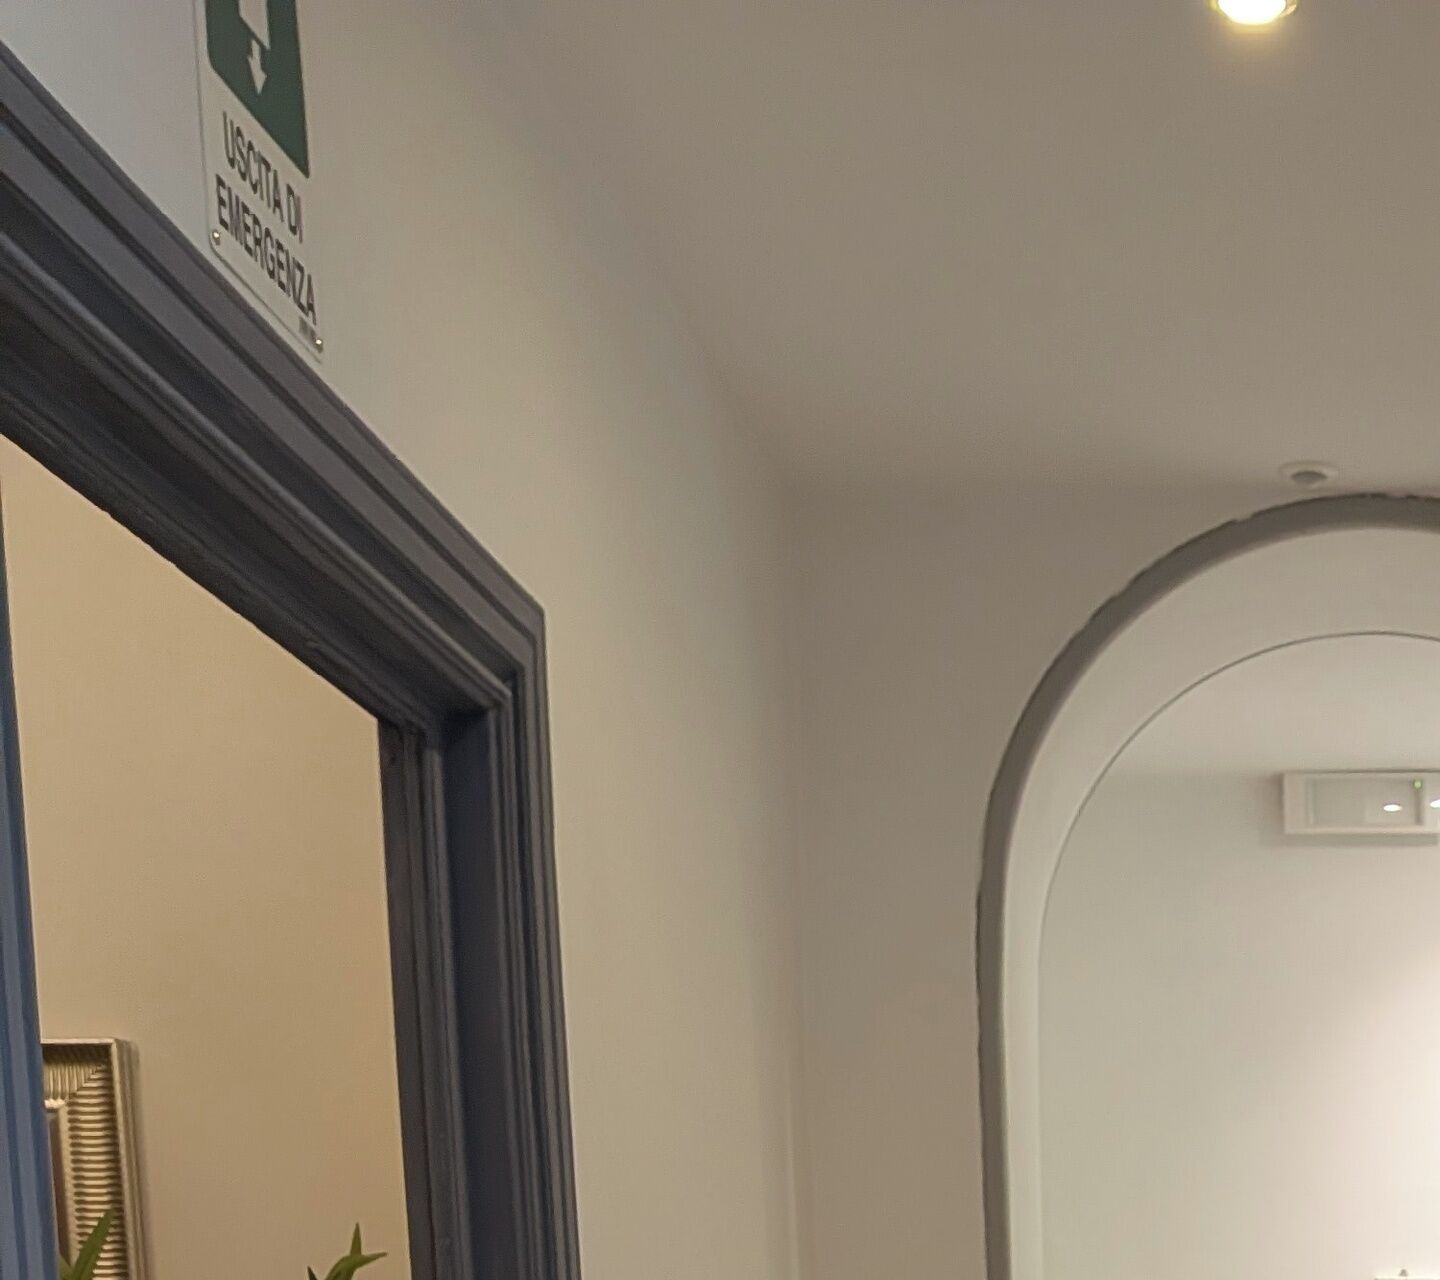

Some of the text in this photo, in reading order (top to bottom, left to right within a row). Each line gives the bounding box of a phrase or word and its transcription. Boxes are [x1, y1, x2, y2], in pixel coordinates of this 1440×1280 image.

[223, 110, 303, 244] USCITA DI
[215, 173, 317, 326] EMERGENZA
